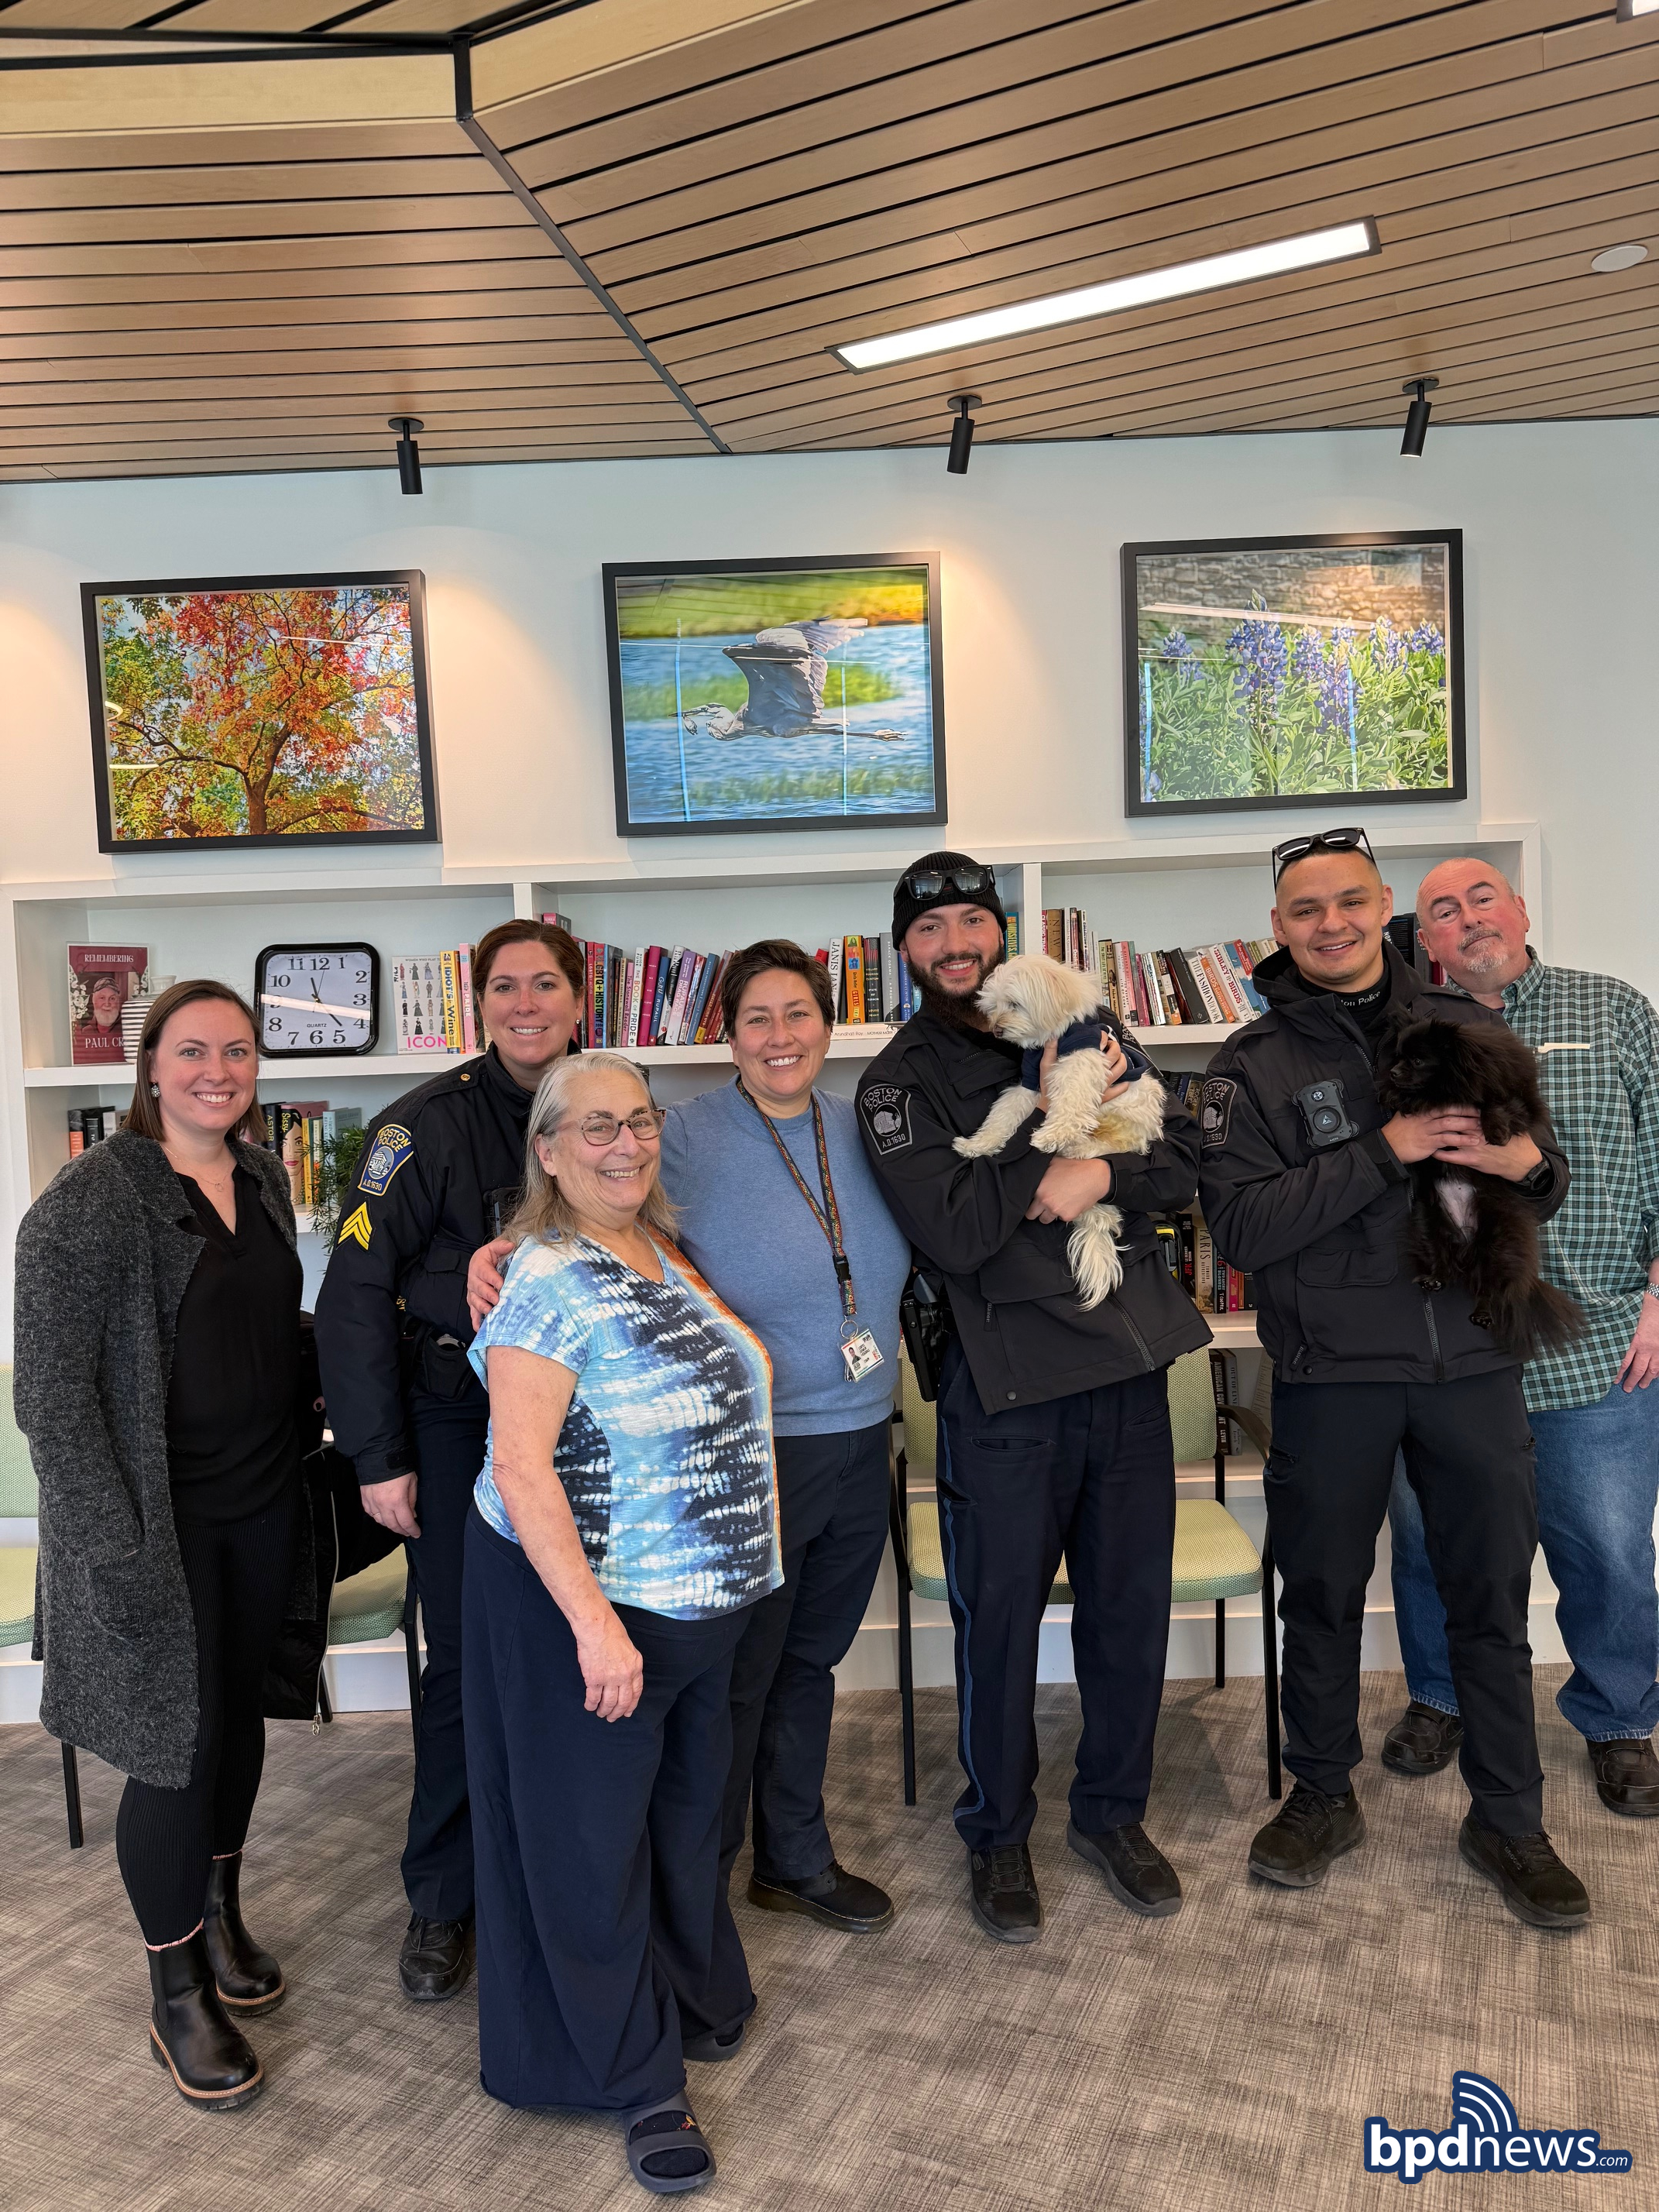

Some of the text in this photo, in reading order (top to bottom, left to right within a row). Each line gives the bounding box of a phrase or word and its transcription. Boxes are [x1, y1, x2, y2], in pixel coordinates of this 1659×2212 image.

[84, 954, 134, 963] REMEMBERING
[287, 957, 306, 970] 11
[310, 957, 330, 970] 12
[338, 957, 345, 969] 1
[830, 942, 840, 970] JANIS
[1214, 949, 1230, 976] SIBLEY
[271, 974, 291, 988] 10
[356, 970, 367, 984] 2
[1205, 967, 1218, 988] BIRDS
[353, 994, 367, 1006] 3
[1228, 981, 1242, 1005] BIRDS
[1358, 991, 1381, 1005] Police
[444, 967, 455, 1036] IDIOT'S Wine
[595, 991, 603, 1025] HISTORY
[268, 1017, 282, 1032] 8
[353, 1015, 366, 1029] 4
[629, 1013, 637, 1036] PRIDE
[85, 1037, 110, 1049] PAUL
[287, 1032, 300, 1045] 7
[310, 1030, 324, 1045] 6
[332, 1029, 346, 1044] 5
[407, 1036, 447, 1049] ICON
[864, 1087, 902, 1107] BOSTON
[868, 1095, 898, 1112] POLICE
[1192, 1087, 1200, 1107] ROGER
[281, 1112, 291, 1133] Sissy
[377, 1137, 404, 1152] POLICE
[380, 1128, 411, 1147] BOSTON
[1200, 1229, 1211, 1260] PARIS
[1214, 1361, 1224, 1393] AMERICAN
